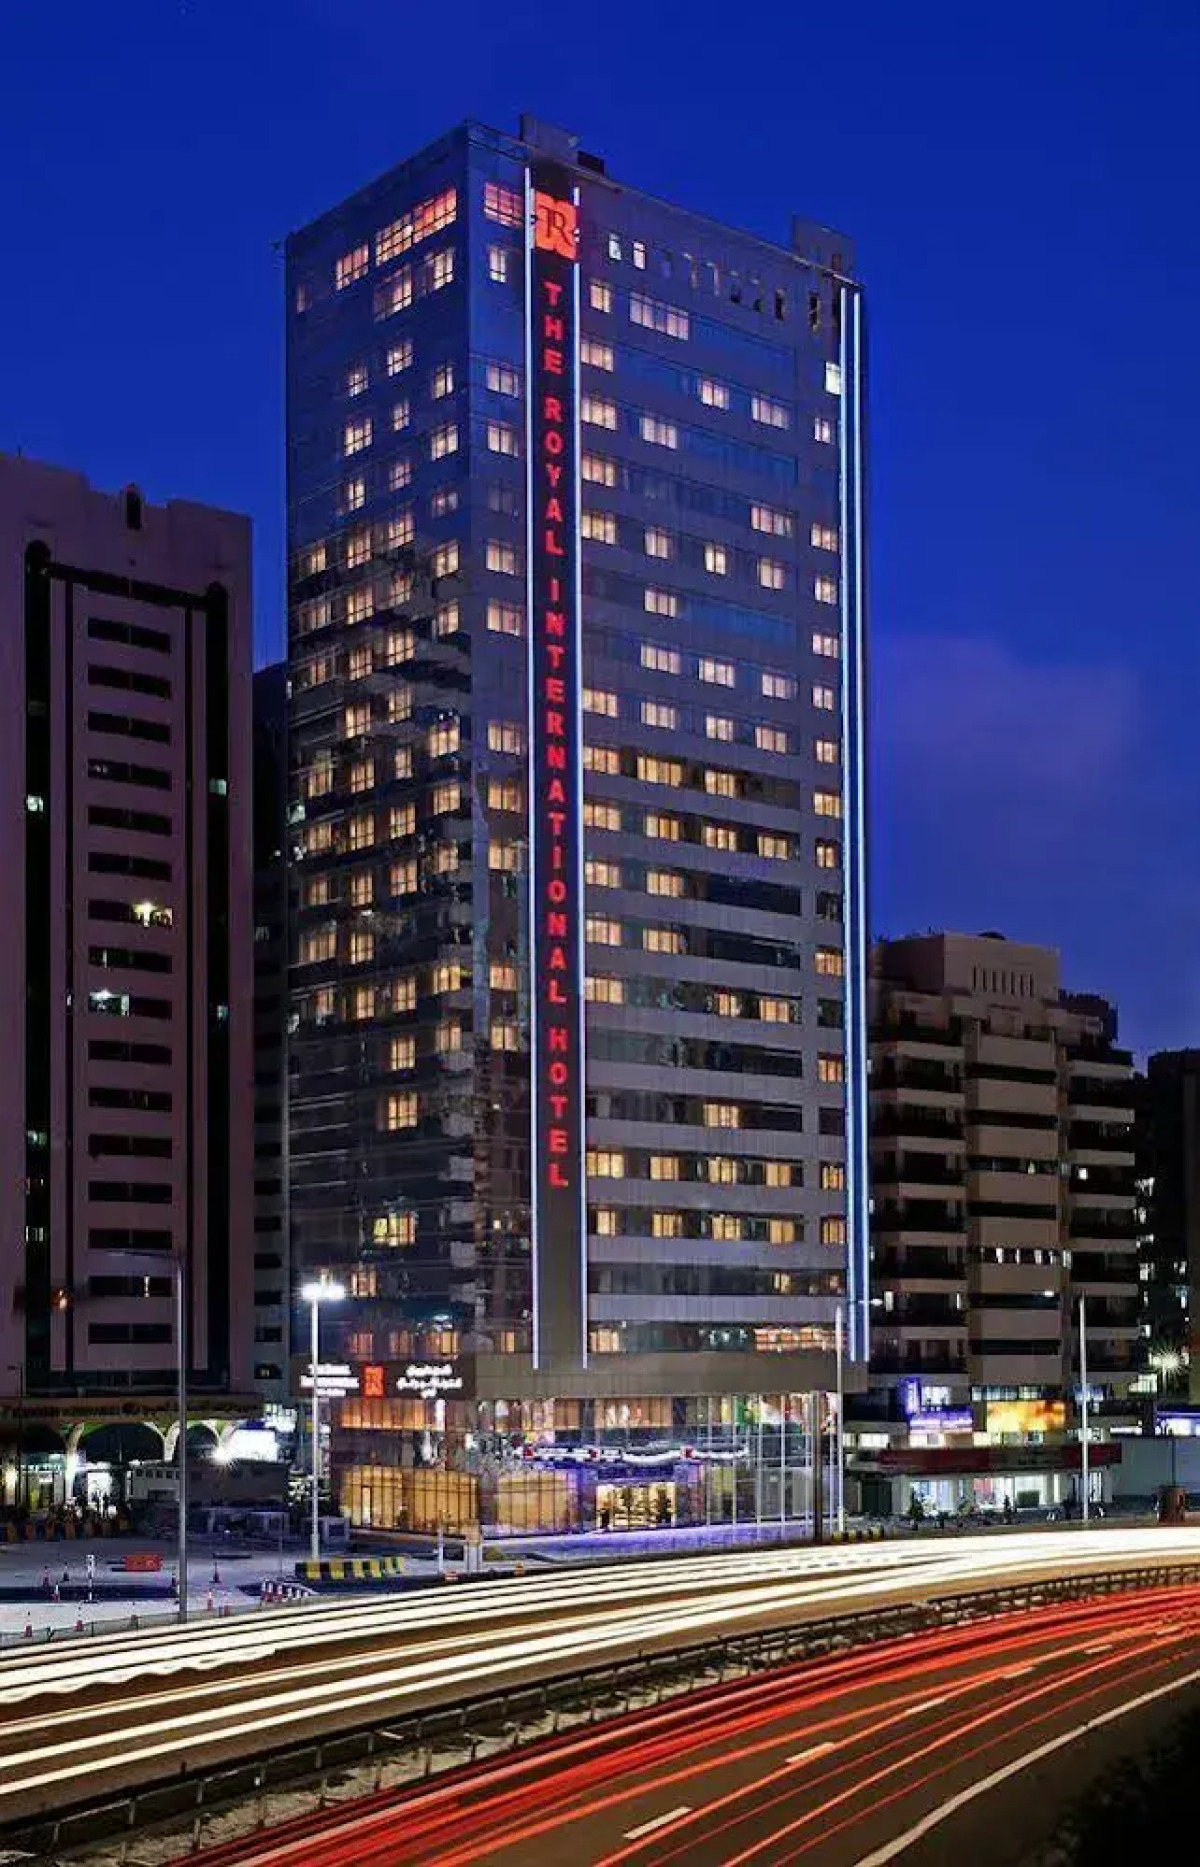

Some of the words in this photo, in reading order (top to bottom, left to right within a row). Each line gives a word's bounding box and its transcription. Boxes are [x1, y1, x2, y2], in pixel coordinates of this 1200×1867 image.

[543, 281, 563, 375] THE
[543, 396, 565, 556] ROYAL
[545, 578, 567, 1004] INTERNATIONAL
[548, 1028, 569, 1188] HOTEL
